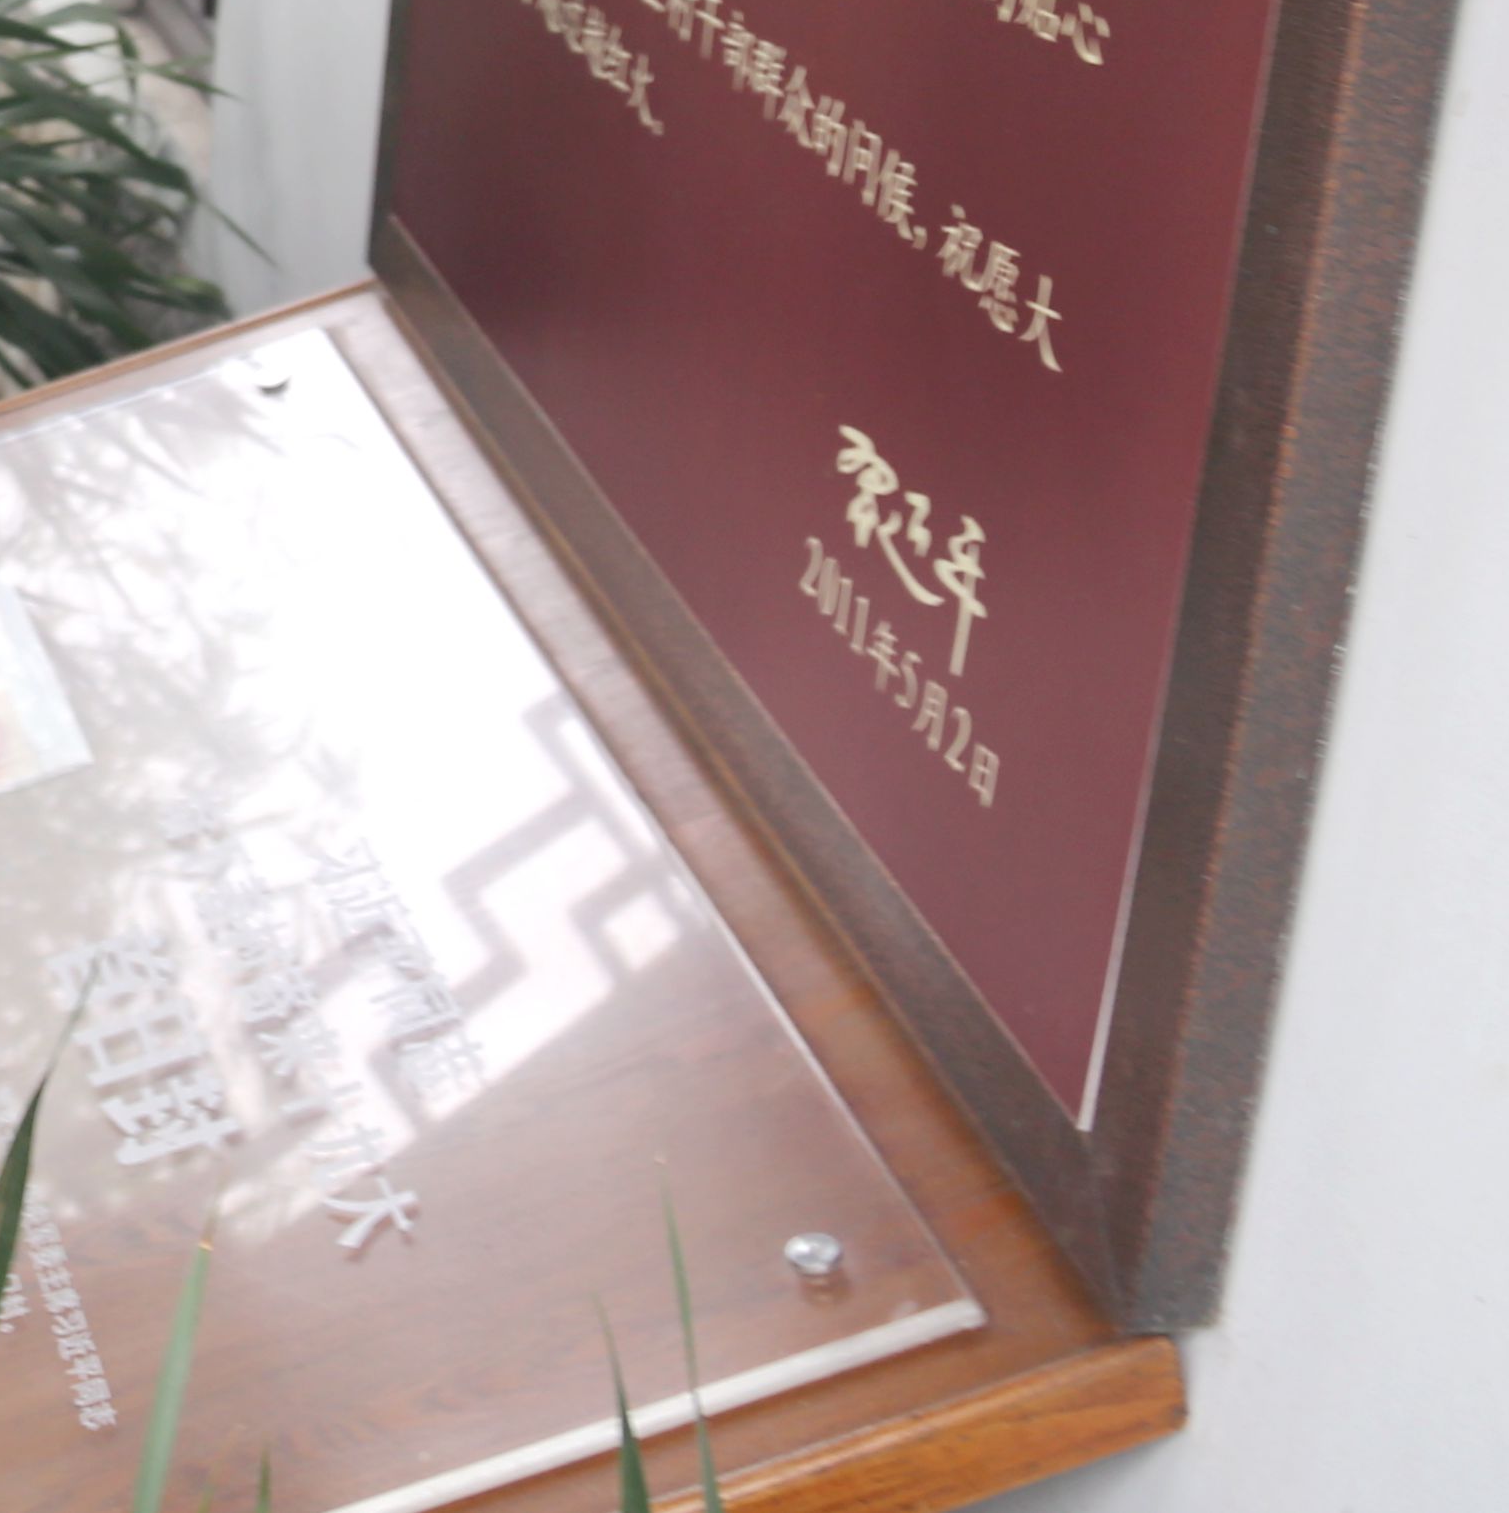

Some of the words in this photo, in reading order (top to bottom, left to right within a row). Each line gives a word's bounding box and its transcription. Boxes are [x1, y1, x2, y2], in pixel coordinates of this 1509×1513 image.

[799, 536, 999, 806] 2011年5月2日
[45, 931, 242, 1165] 首日封
